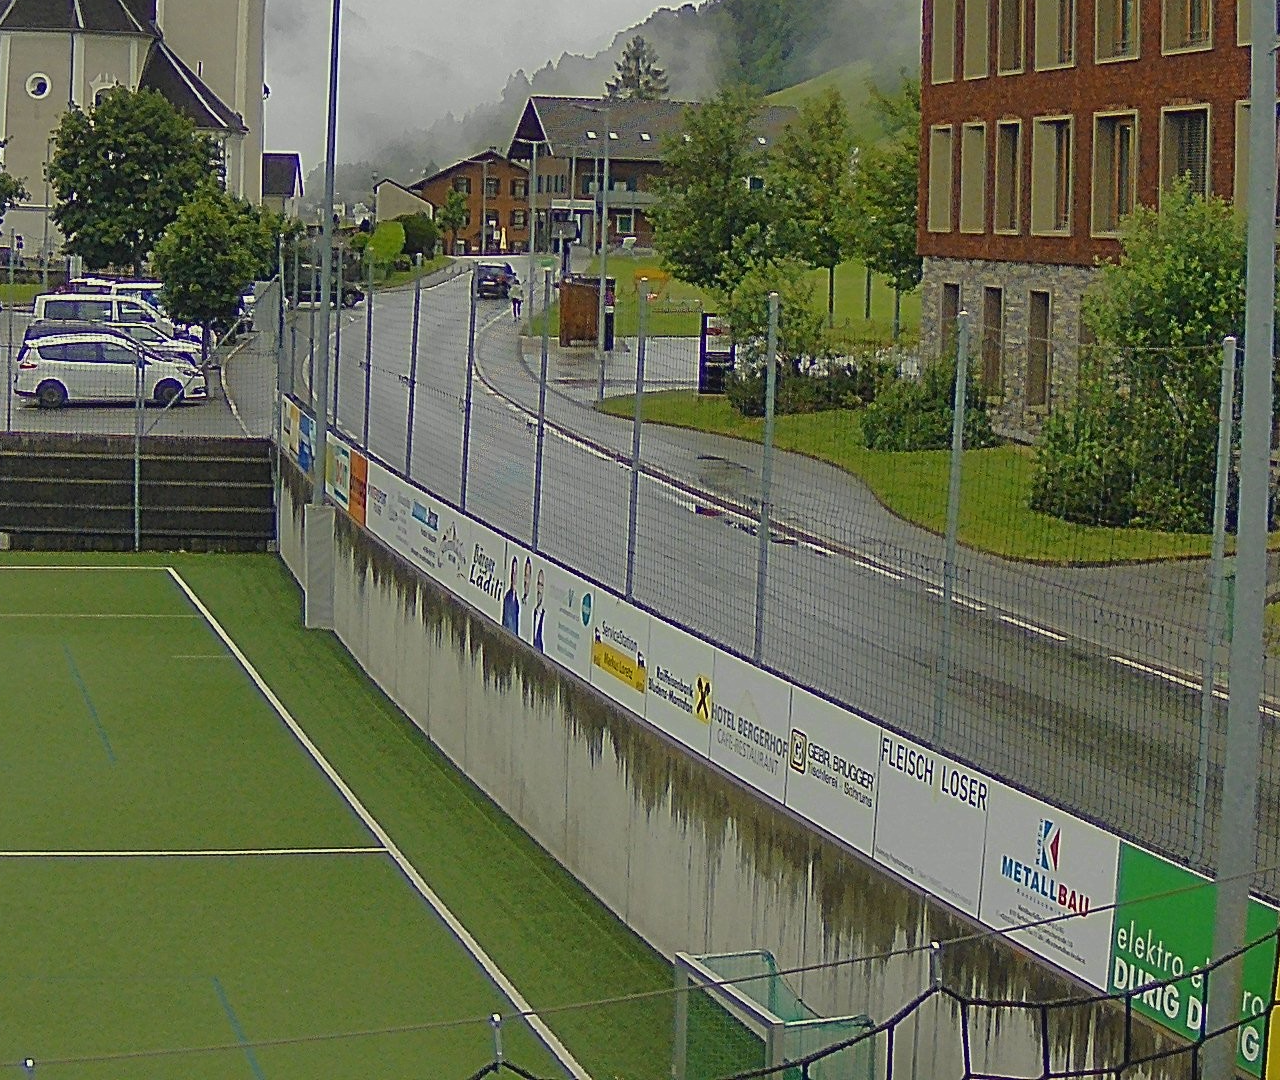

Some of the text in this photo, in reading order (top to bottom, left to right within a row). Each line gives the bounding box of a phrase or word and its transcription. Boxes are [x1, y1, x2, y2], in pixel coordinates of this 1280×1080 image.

[656, 665, 694, 699] Raiffeisenbank
[712, 702, 736, 732] HOTEL
[737, 716, 789, 759] BERGERHOF
[807, 742, 832, 768] GEBR.
[833, 755, 875, 792] BRUGGER
[881, 737, 988, 811] FLEISCH LOSER
[1001, 854, 1090, 917] METALLBAU
[1117, 920, 1184, 977] elektro
